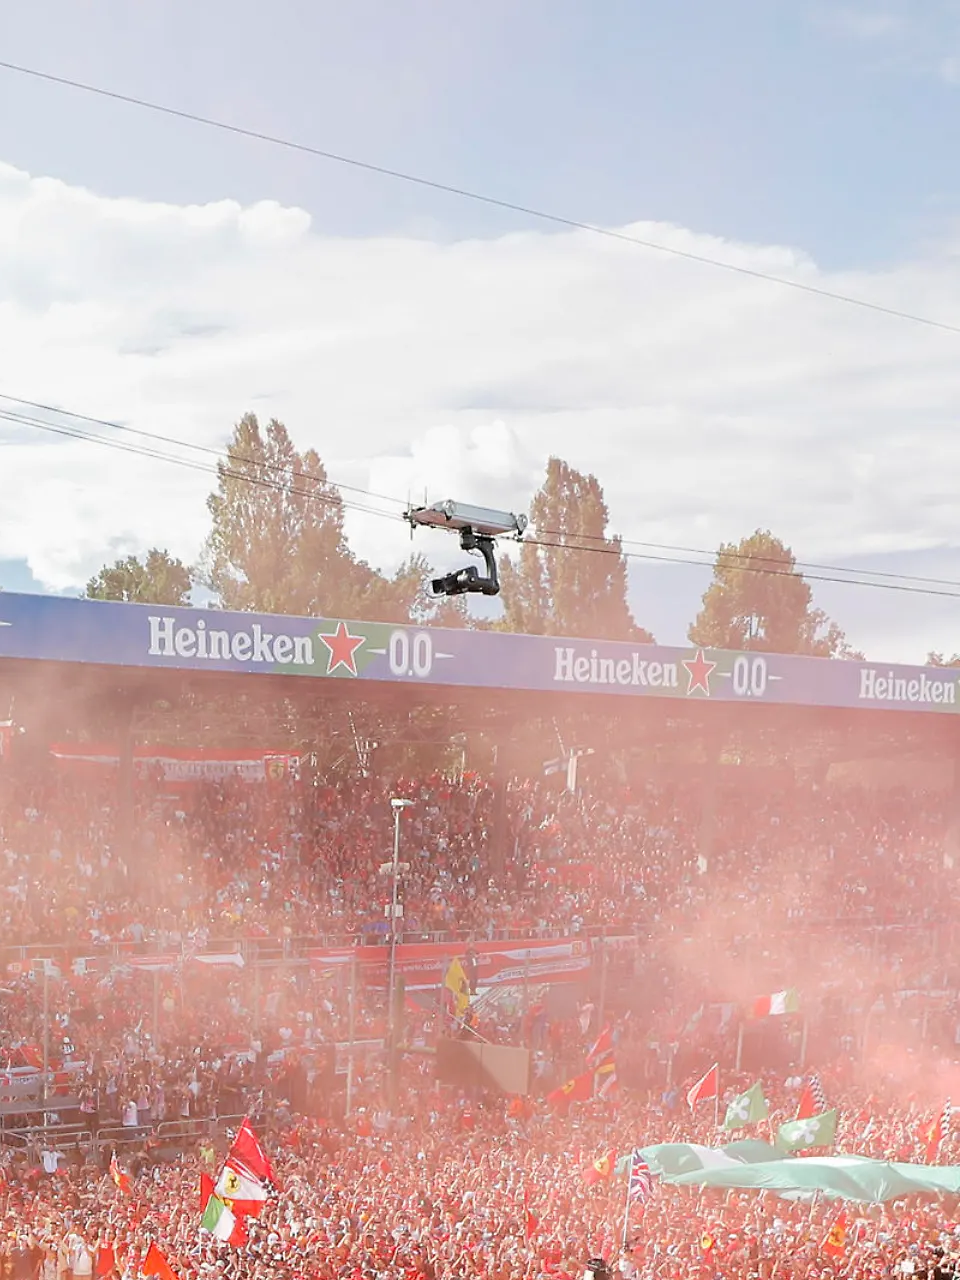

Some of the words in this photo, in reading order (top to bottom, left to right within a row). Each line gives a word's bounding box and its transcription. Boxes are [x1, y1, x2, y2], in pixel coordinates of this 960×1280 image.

[148, 616, 315, 665] Heineken
[389, 629, 433, 677] 0.0
[553, 647, 678, 688] Heineken
[732, 656, 766, 696] 0.0
[858, 668, 957, 705] Heineken
